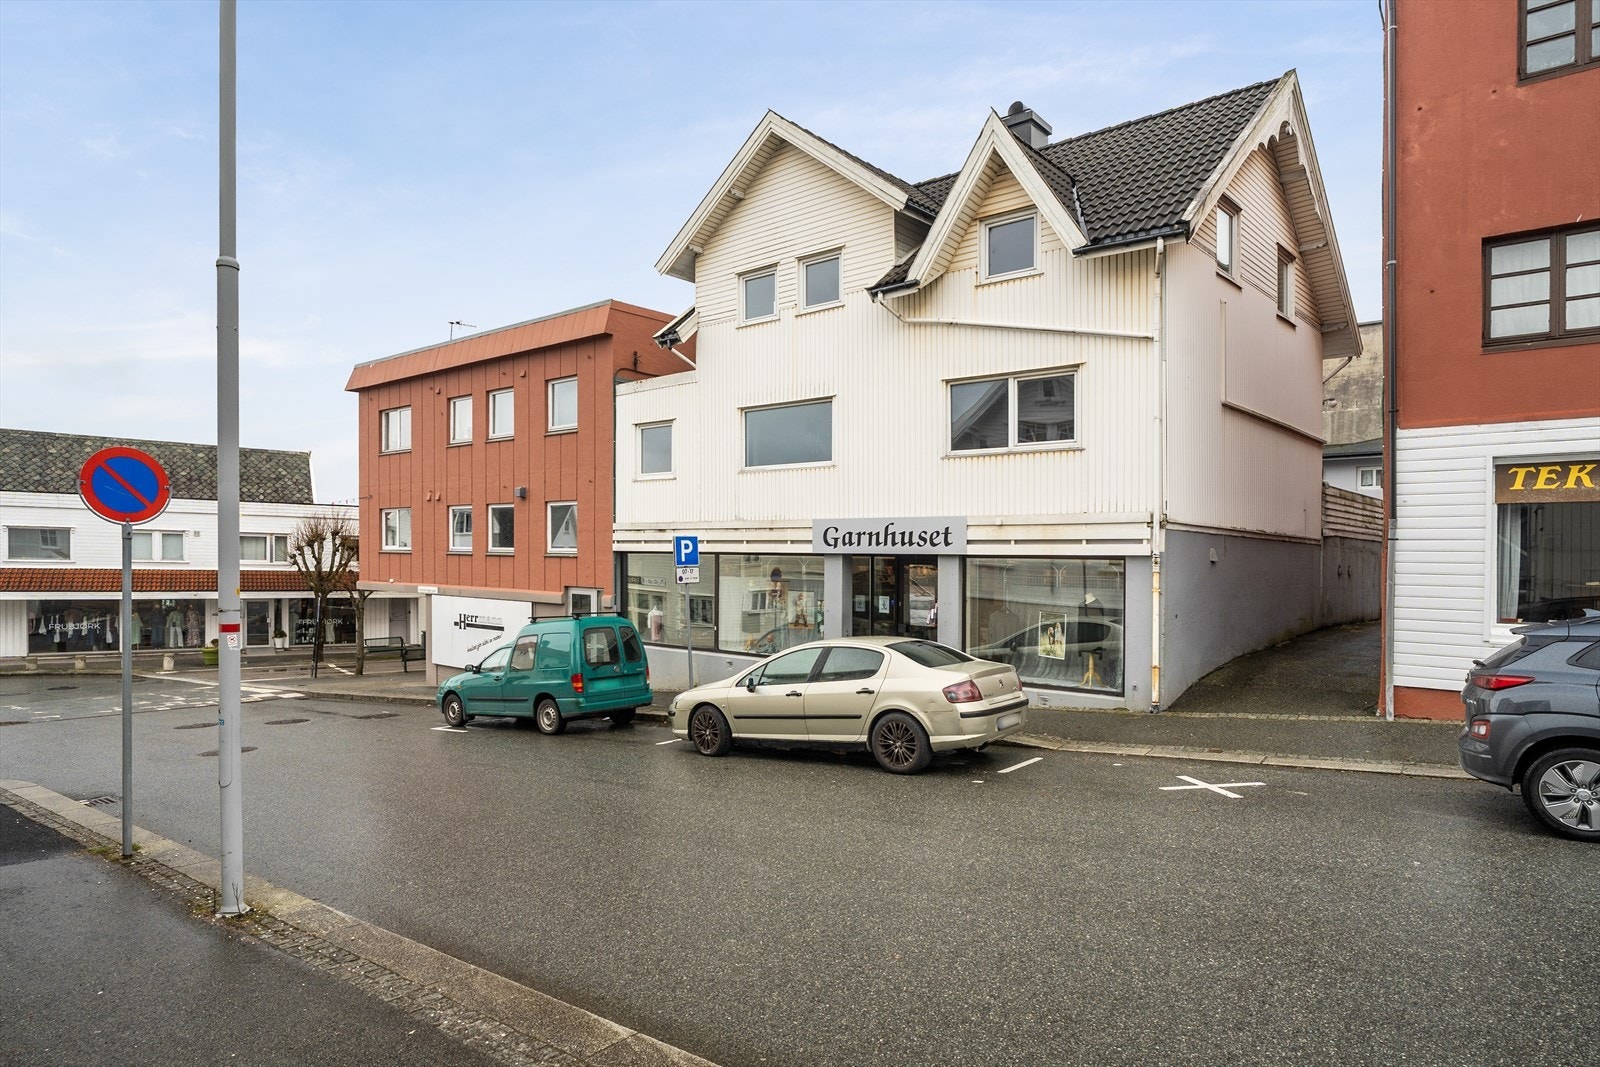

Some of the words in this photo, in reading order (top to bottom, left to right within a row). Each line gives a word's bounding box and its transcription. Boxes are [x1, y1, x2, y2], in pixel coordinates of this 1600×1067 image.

[1507, 464, 1598, 490] TEK
[822, 522, 954, 549] Garnhuset
[680, 539, 694, 562] P
